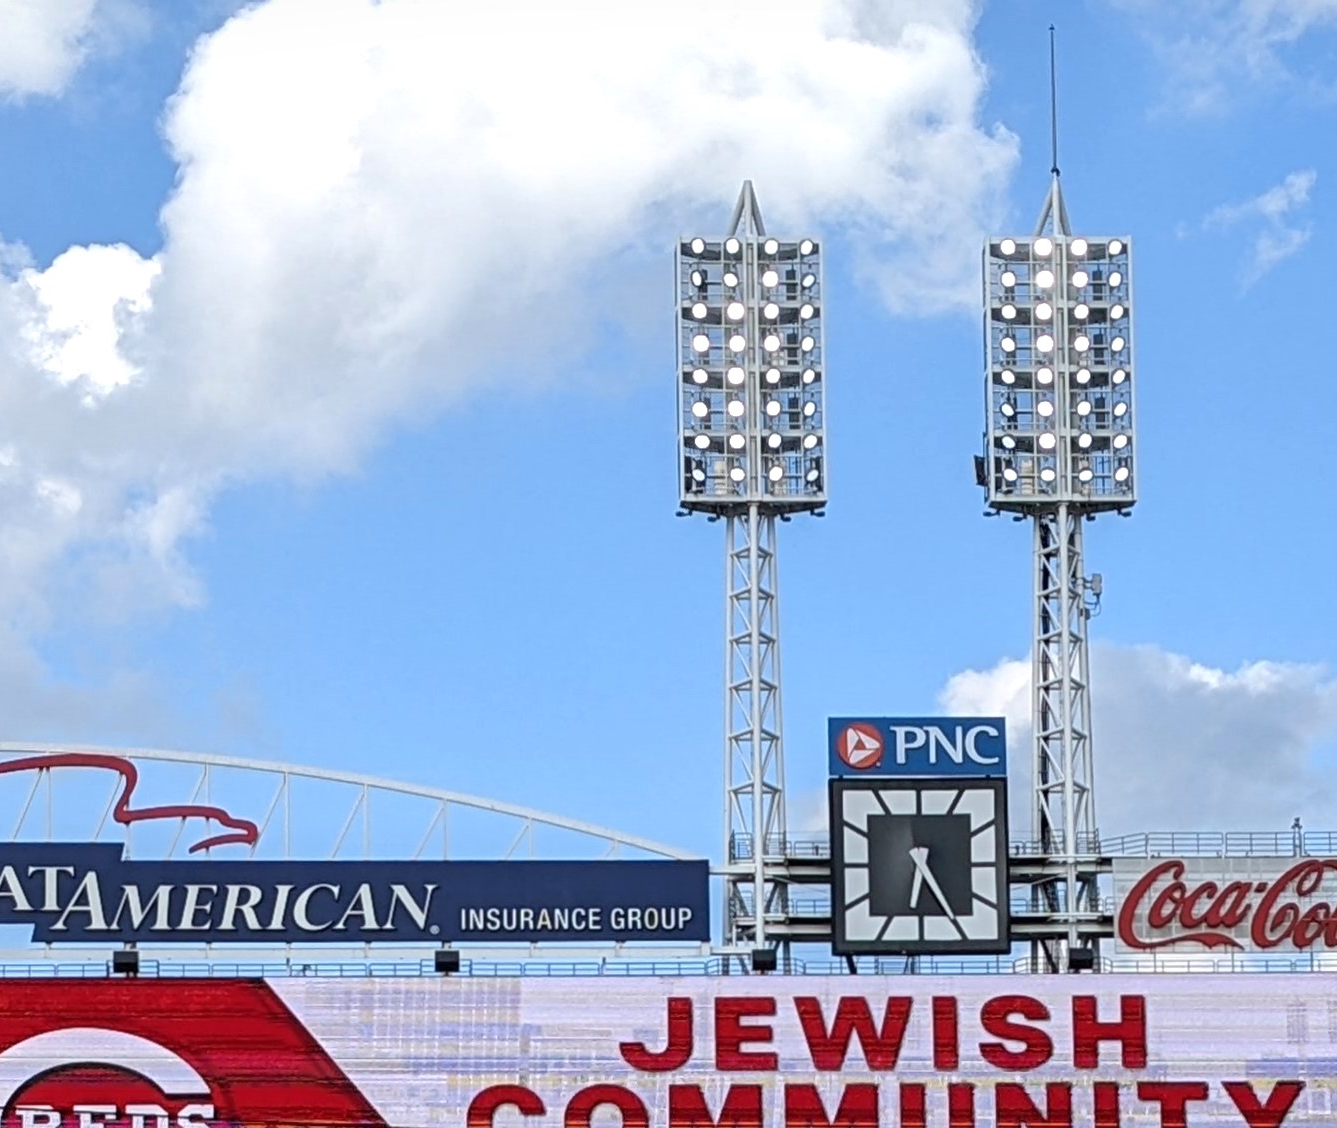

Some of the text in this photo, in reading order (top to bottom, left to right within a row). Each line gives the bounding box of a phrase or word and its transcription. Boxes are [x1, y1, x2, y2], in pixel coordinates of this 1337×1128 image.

[890, 725, 1000, 765] PNC
[51, 871, 440, 934] AMERICAN
[459, 906, 603, 932] INSURANCE
[610, 904, 693, 931] GROUP
[618, 994, 1149, 1073] JEWISH
